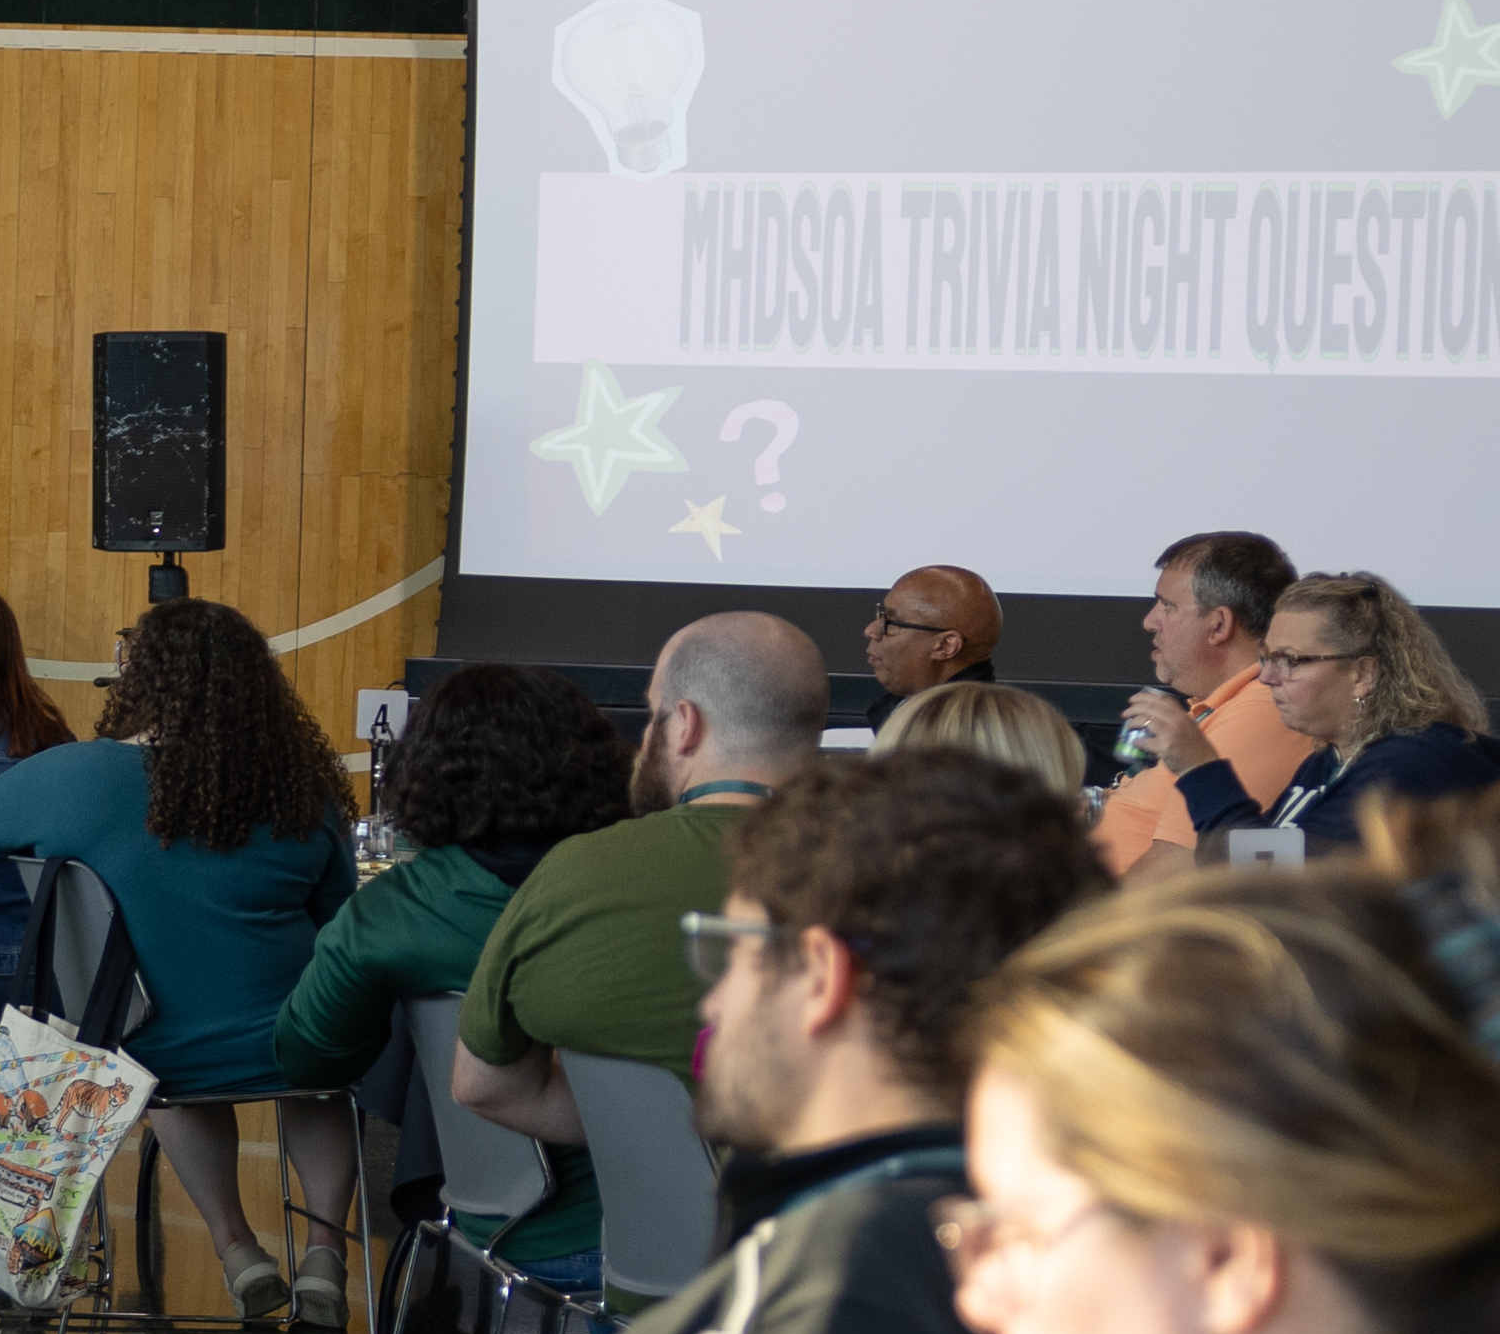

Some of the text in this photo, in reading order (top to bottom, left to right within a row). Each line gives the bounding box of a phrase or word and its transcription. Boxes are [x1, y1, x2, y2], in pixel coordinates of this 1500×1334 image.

[678, 180, 885, 355] MHDSOA
[900, 181, 1061, 357] TRIVIA
[1076, 179, 1239, 360] NIGHT
[373, 703, 389, 734] 4
